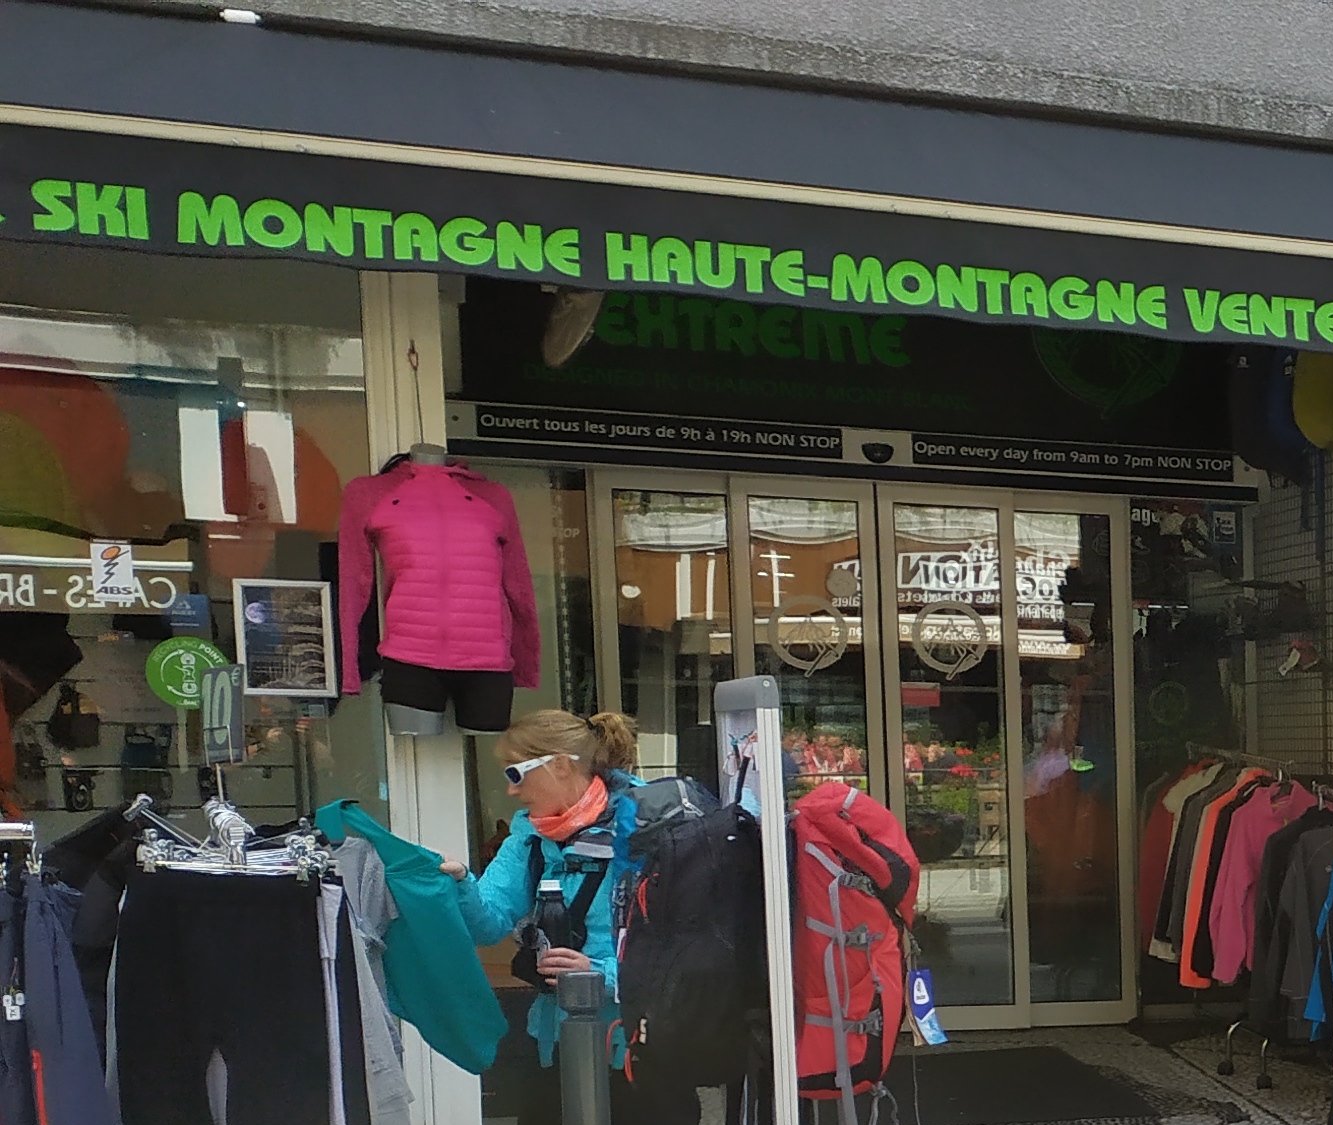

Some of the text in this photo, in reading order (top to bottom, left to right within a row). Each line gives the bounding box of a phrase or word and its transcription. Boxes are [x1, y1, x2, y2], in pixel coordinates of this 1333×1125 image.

[31, 179, 149, 239] SKI
[177, 191, 581, 276] MONTAGNE
[606, 232, 1167, 329] HAUTE-MONTAGNE
[596, 290, 912, 367] EXTREME
[480, 413, 840, 450] Ouvert tous les jours de 9h à 19h NON STOP
[914, 441, 1232, 472] Open every day from 9am to 7pm NON STOP
[96, 585, 133, 595] ABS
[152, 640, 224, 664] RECYCLING POINT
